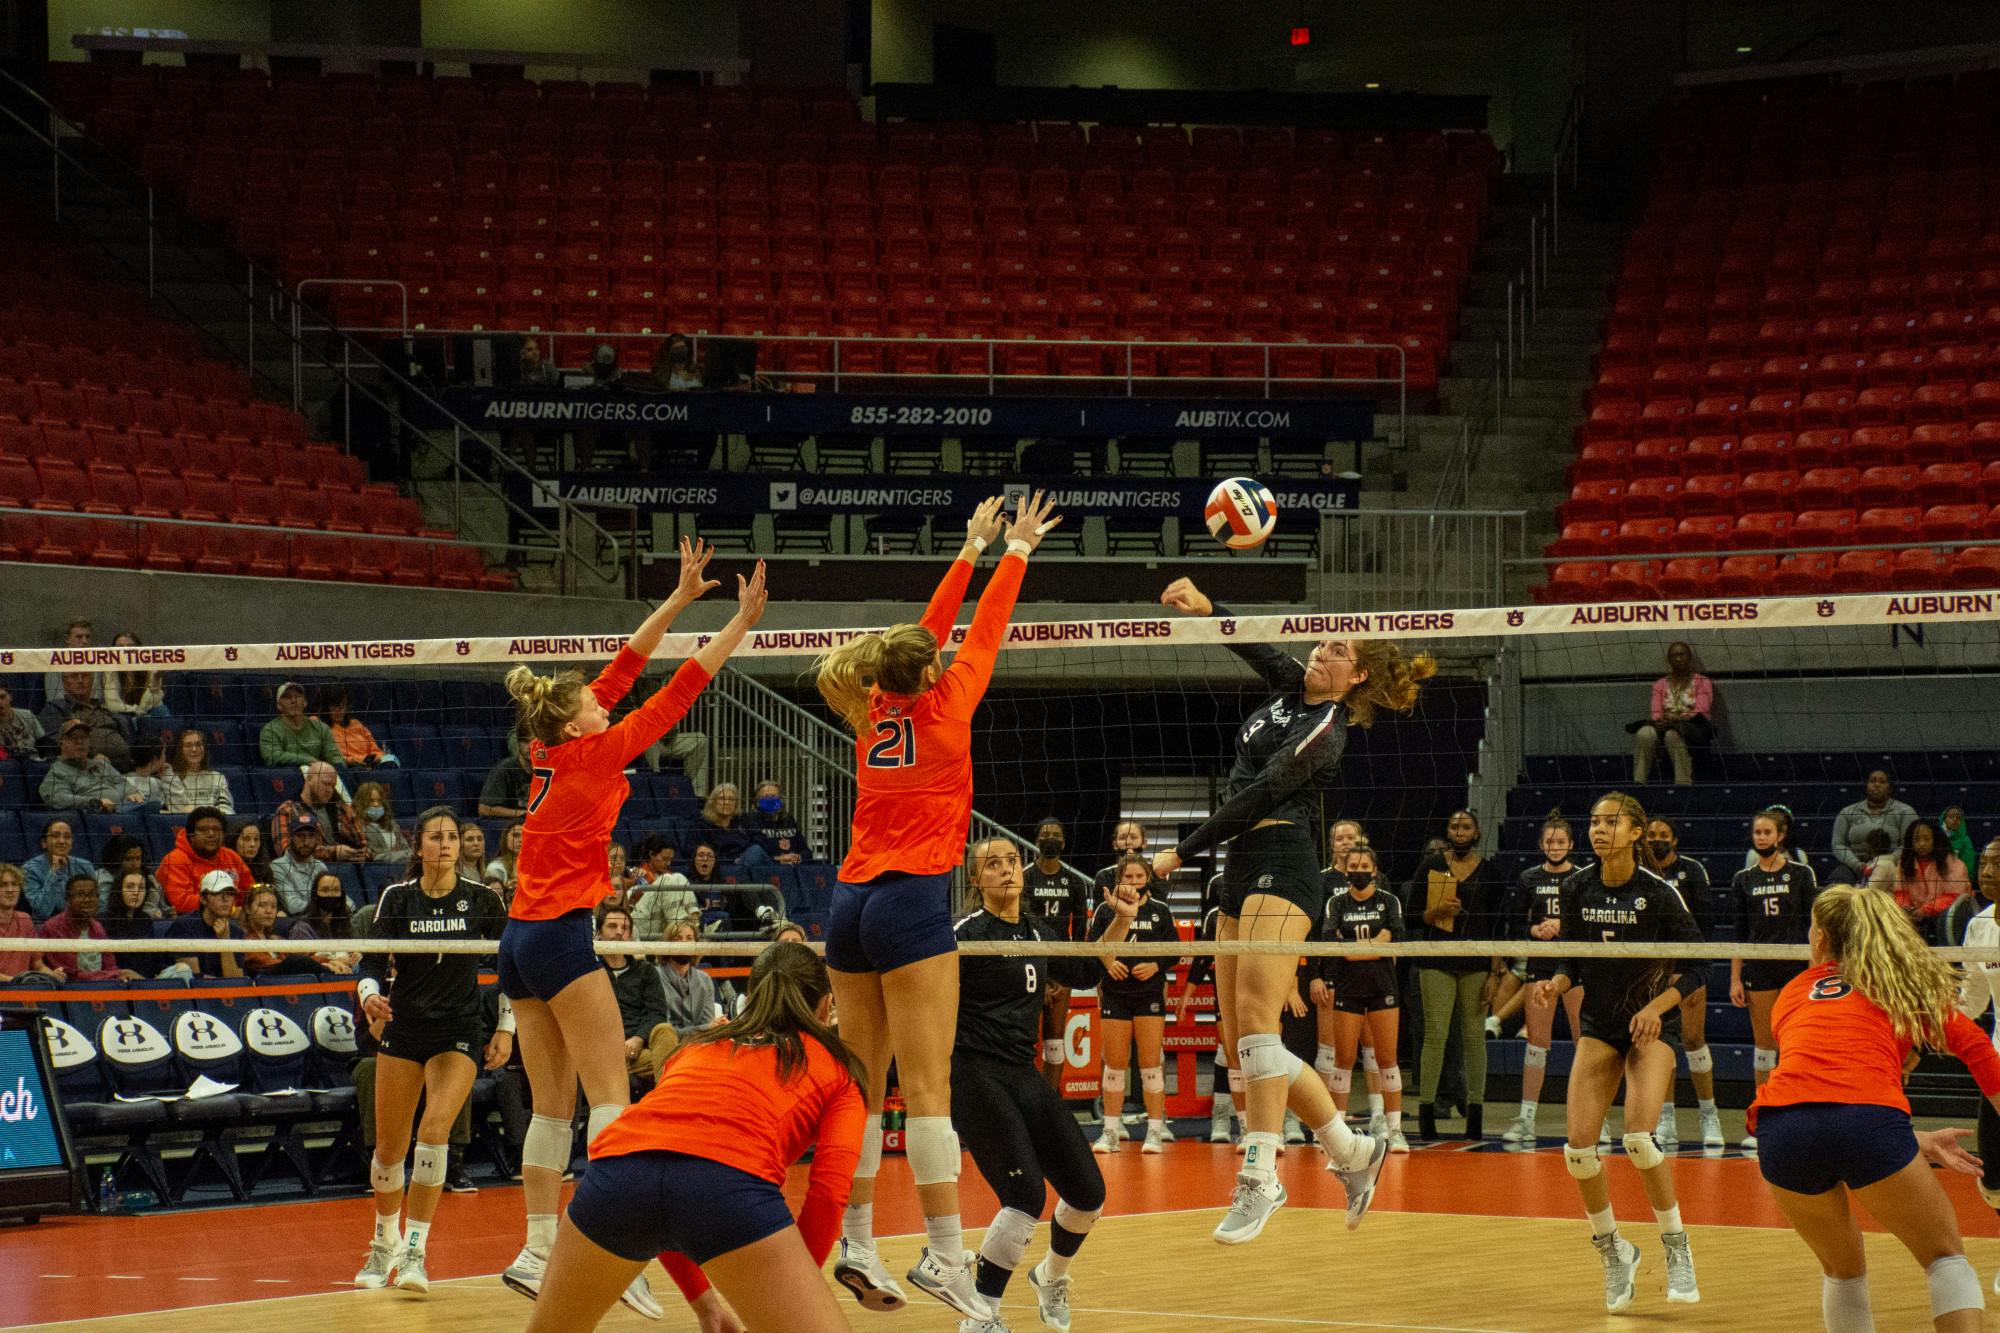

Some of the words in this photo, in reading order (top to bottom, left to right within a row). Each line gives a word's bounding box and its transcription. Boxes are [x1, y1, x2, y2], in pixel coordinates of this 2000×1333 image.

[484, 401, 689, 422] AUBURNTIGERS.COM
[850, 406, 993, 426] 855-282-2010
[1174, 410, 1291, 429] AUBTIX.COM
[800, 487, 953, 507] @AUBURNTIGERS
[1570, 604, 1670, 625] AUBURN
[1672, 602, 1759, 623] TIGERS
[1885, 593, 1993, 616] AUBURN
[1007, 622, 1094, 643] AUBURN
[1097, 620, 1172, 639] TIGERS
[1279, 615, 1375, 635] AUBURN
[1377, 612, 1455, 632] TIGERS
[508, 637, 585, 655] AUBURN
[588, 636, 630, 653] TIGE
[752, 632, 833, 650] AUBURN
[50, 648, 121, 665] AUBURN
[123, 647, 186, 664] TIGERS
[275, 643, 349, 661] AUBURN
[351, 642, 416, 659] TIGERS
[866, 716, 916, 769] 21
[527, 766, 555, 816] 7
[1034, 887, 1070, 897] CAROLINA
[1536, 885, 1560, 895] CAROL
[1752, 884, 1790, 897] CAROLINA
[1044, 900, 1060, 917] 14
[1545, 897, 1560, 915] 16
[1762, 897, 1780, 917] 15
[410, 917, 467, 934] CAROLINA
[1130, 920, 1153, 930] OLINA
[1581, 907, 1638, 925] CAROLINA
[1353, 924, 1370, 941] 10
[1024, 963, 1038, 993] 8
[1166, 997, 1216, 1006] ATRADE
[1162, 1036, 1217, 1046] ATORADE
[1065, 1081, 1099, 1092] GATORADE
[0, 1076, 38, 1123] ch
